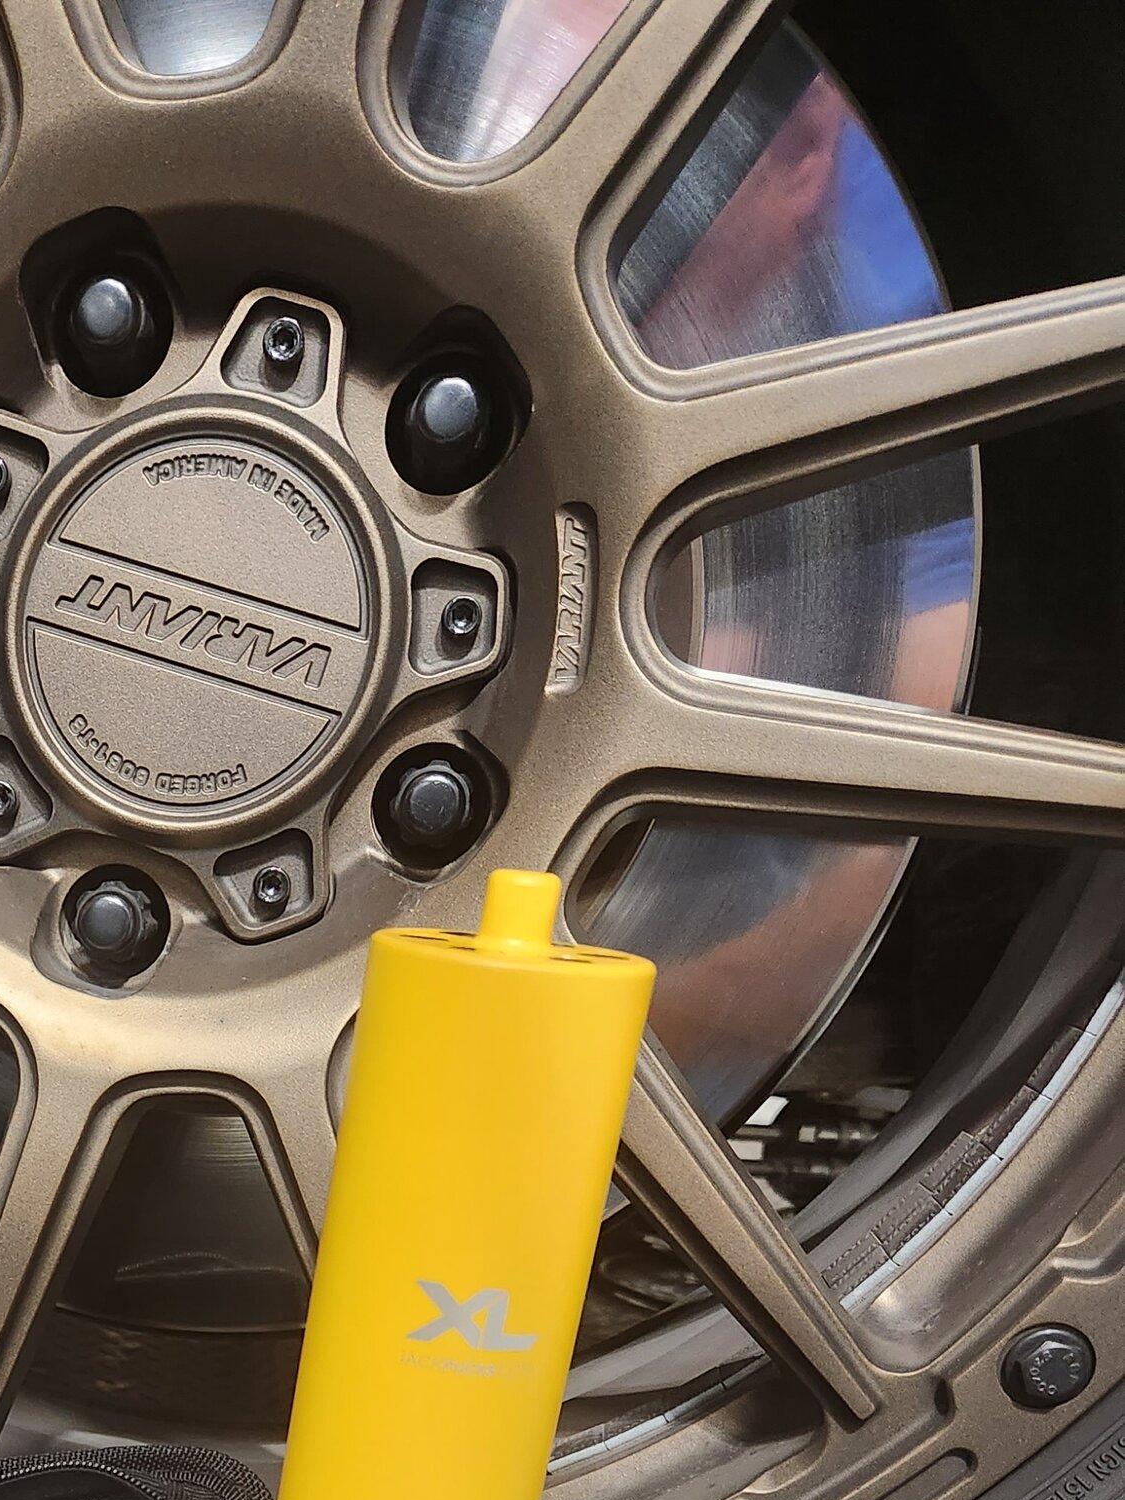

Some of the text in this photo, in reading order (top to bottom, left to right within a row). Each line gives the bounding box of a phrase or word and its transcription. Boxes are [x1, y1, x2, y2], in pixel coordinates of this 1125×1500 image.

[142, 452, 330, 542] MADE IN AMERICA
[55, 573, 333, 691] VARIANT
[555, 516, 588, 683] VARIANT
[155, 763, 248, 795] FORGED
[406, 1277, 540, 1352] XL
